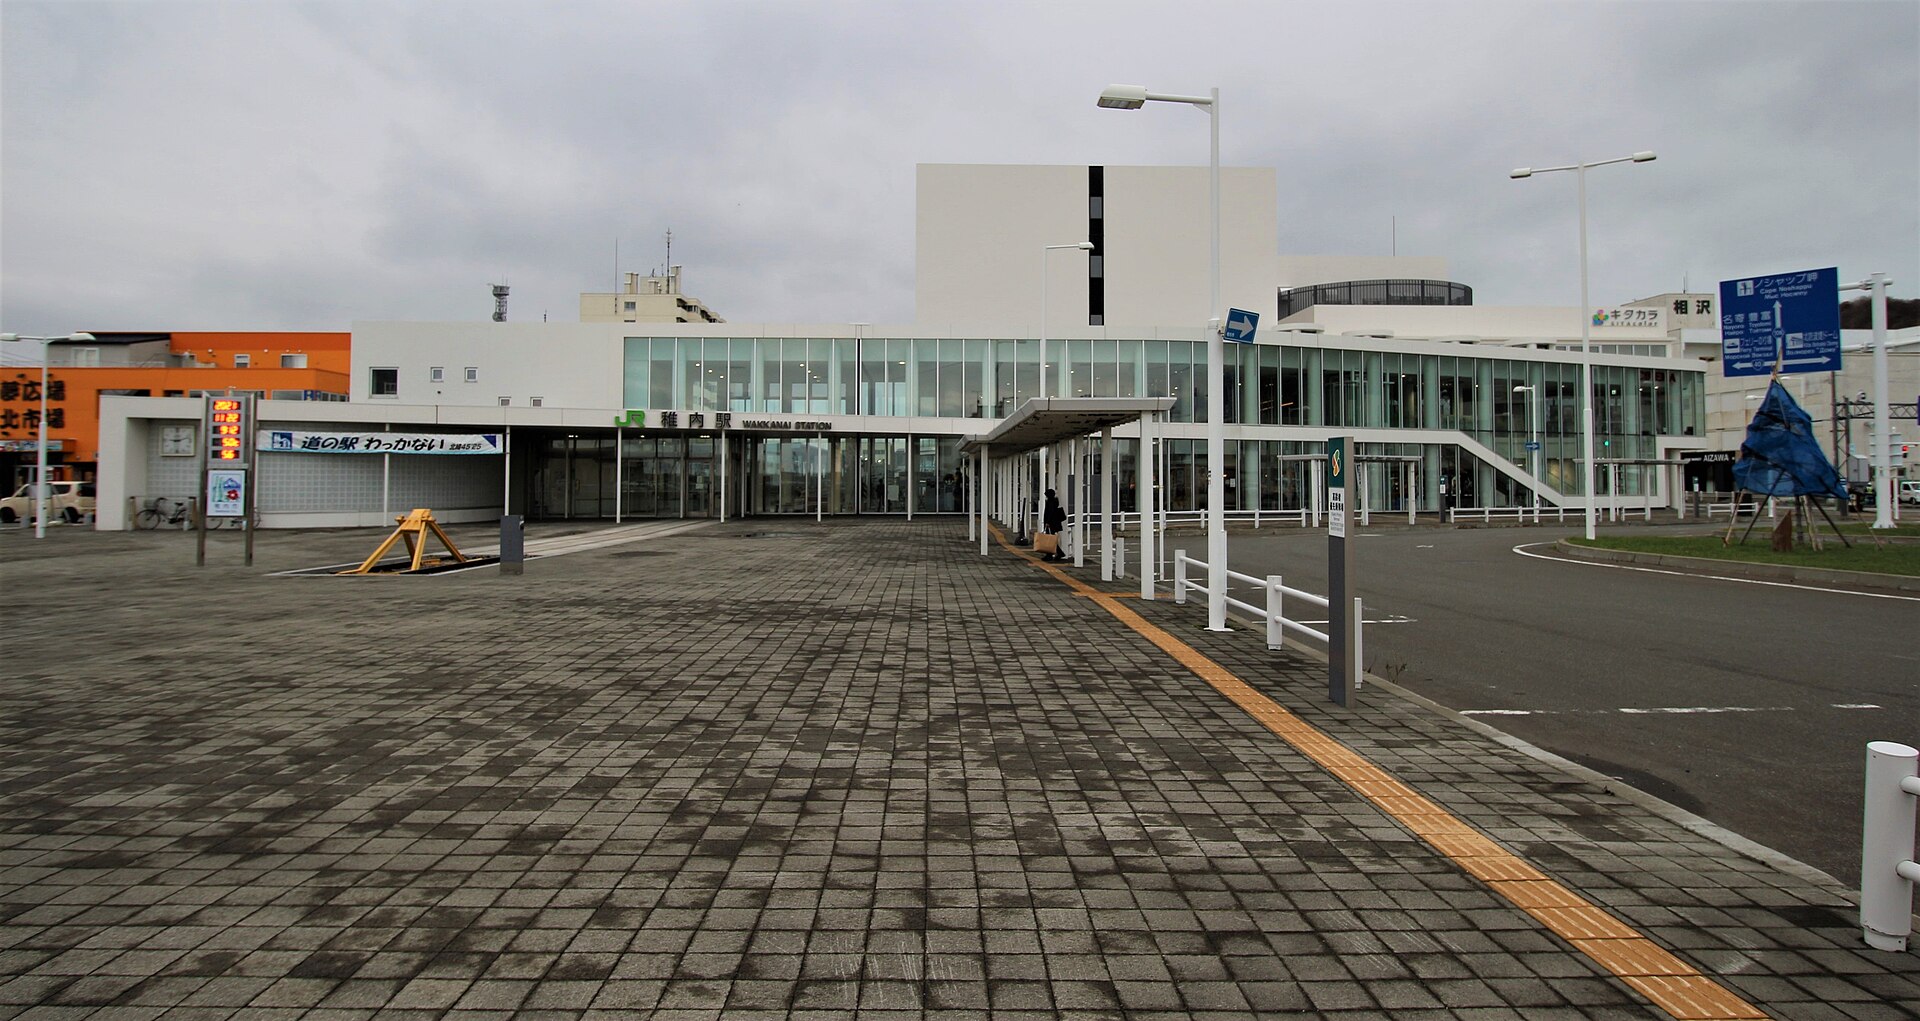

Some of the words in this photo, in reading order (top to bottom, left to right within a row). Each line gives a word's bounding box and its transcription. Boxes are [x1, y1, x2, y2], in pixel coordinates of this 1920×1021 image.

[1754, 272, 1818, 289] ノシャップ岬
[1610, 309, 1658, 320] キタカラ
[1673, 300, 1711, 315] 相沢
[614, 410, 646, 428] JR
[660, 411, 732, 429] 稚内駅
[742, 420, 792, 430] WAKKANAI
[794, 421, 832, 430] STATION
[301, 436, 360, 450] 道の駅
[364, 436, 444, 450] わっかない
[1703, 454, 1729, 462] AIZAWA
